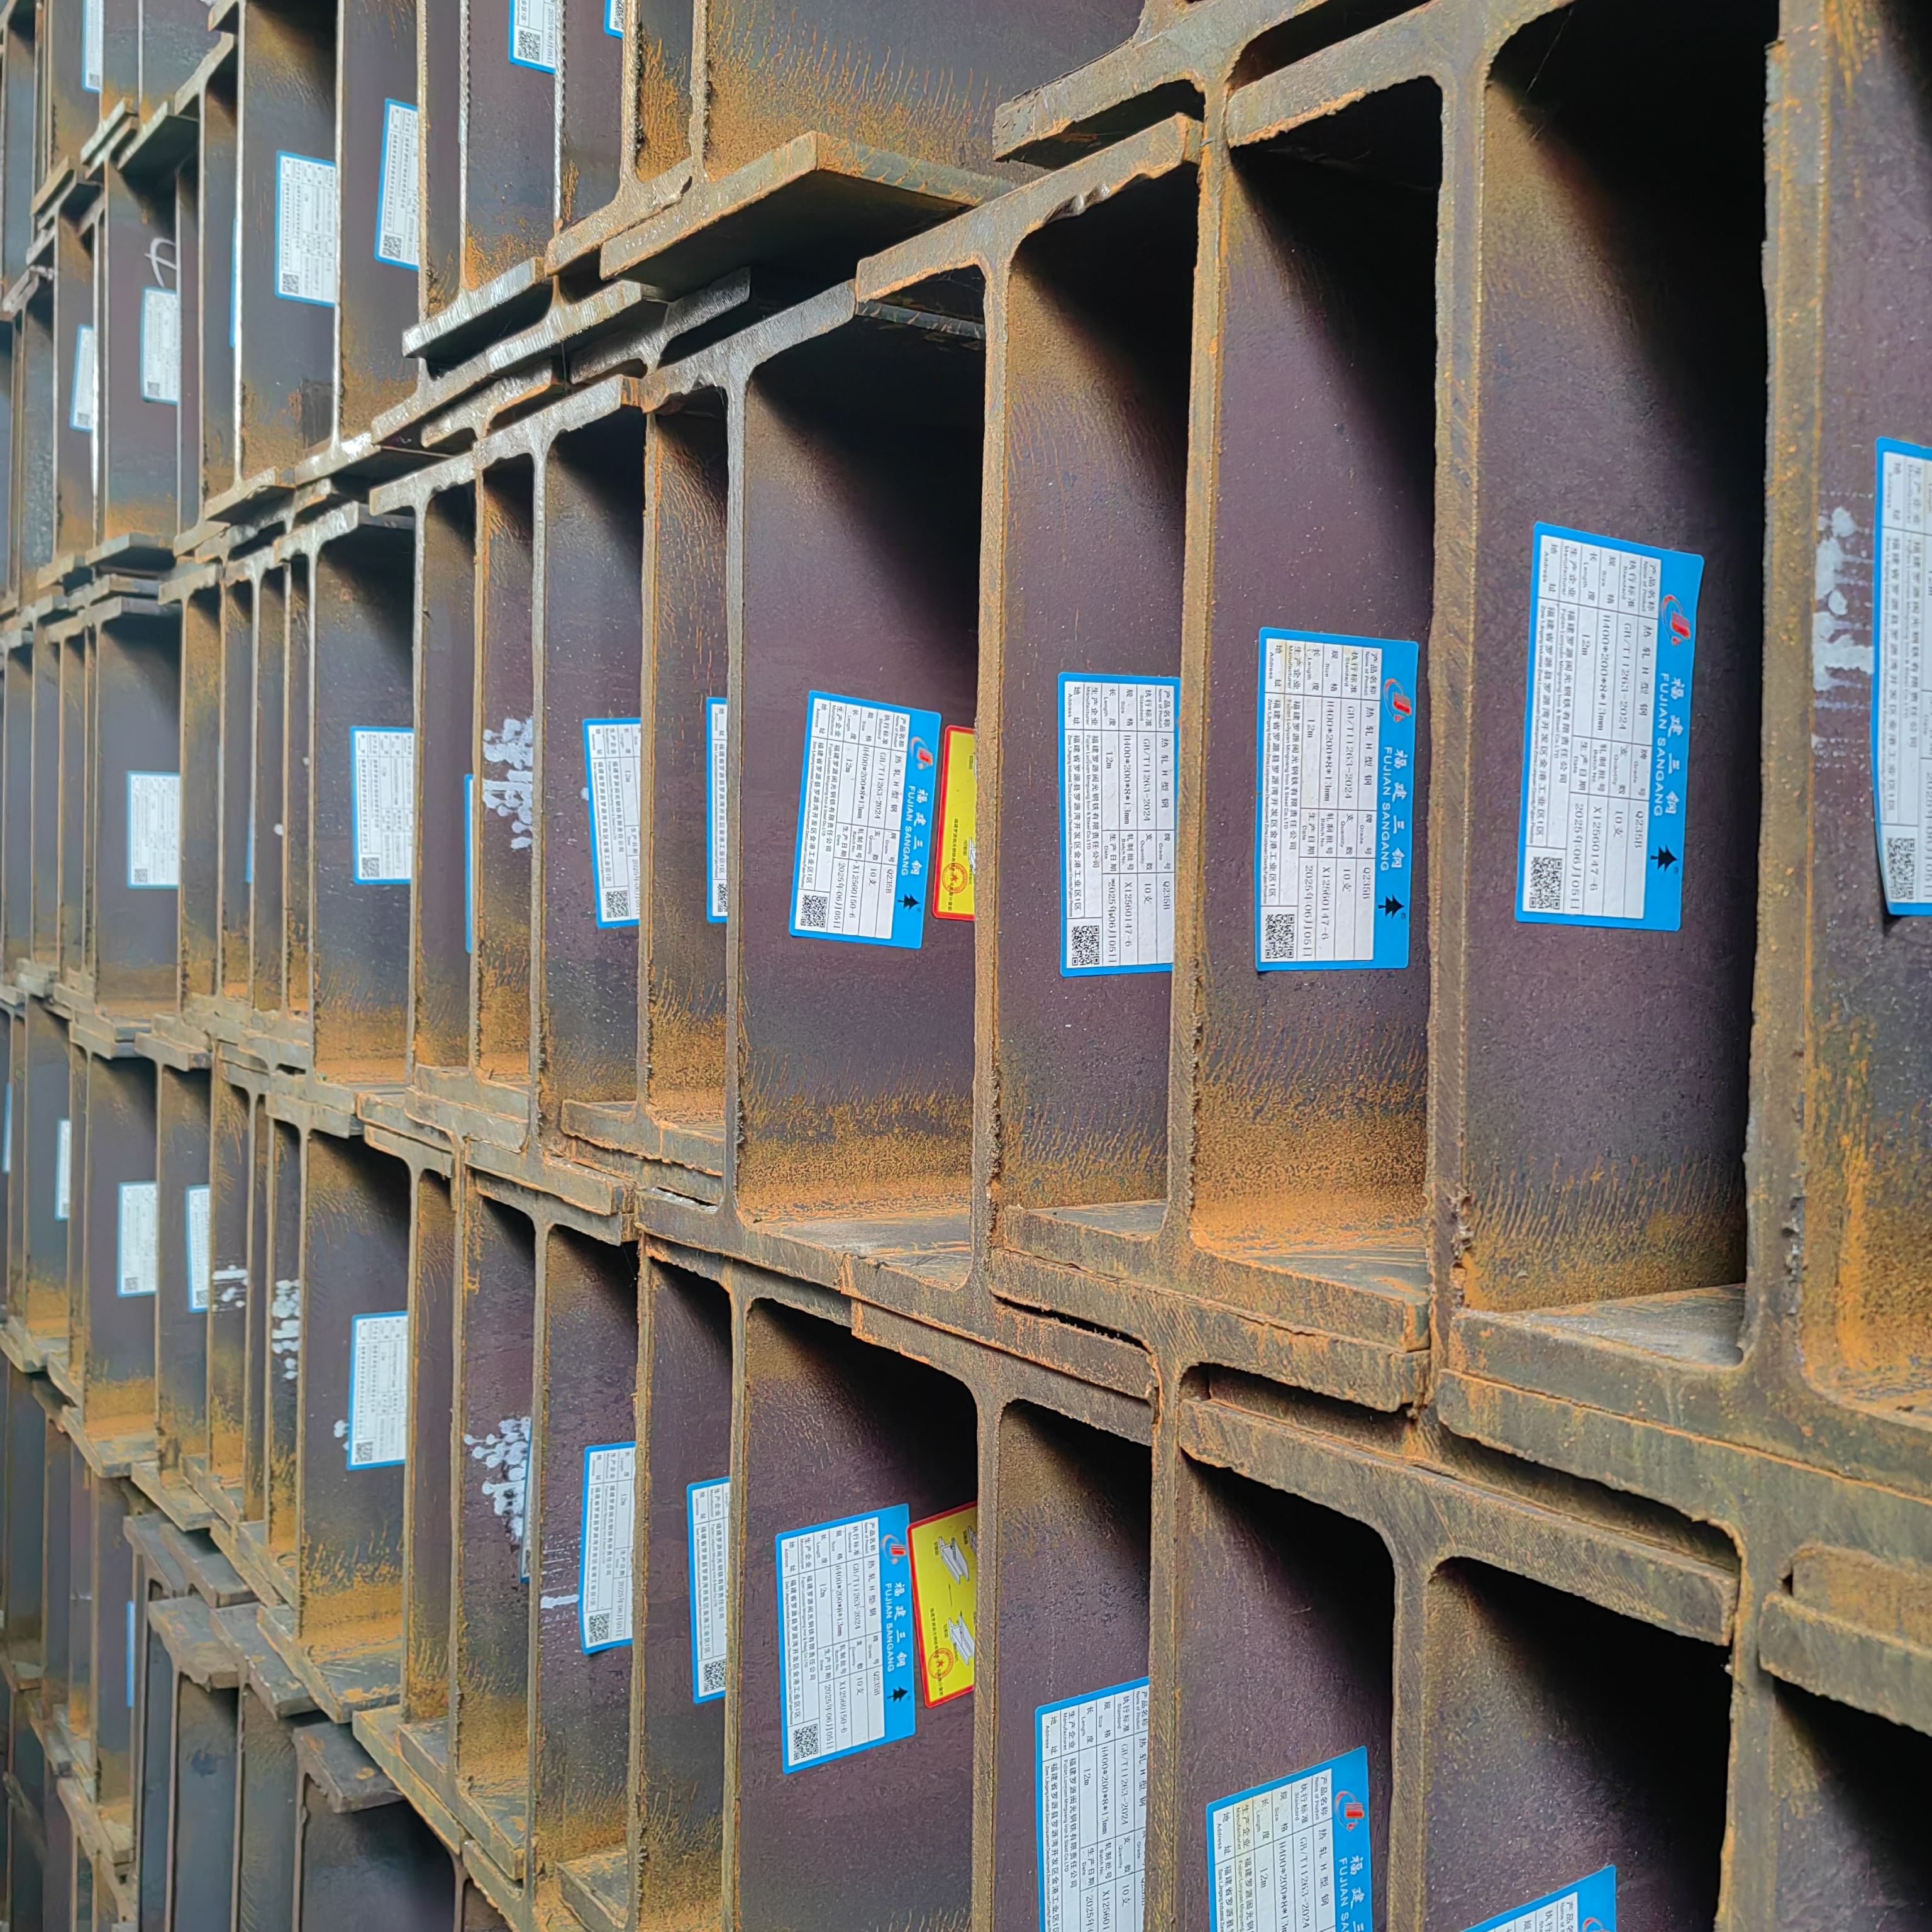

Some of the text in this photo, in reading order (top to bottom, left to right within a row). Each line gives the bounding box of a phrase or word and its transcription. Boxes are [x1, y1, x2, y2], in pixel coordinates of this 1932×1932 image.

[1567, 547, 1577, 597] 生产企业
[1626, 559, 1636, 608] 执行标准
[1646, 563, 1657, 612] 产品名称
[1580, 633, 1590, 656] 12m
[1292, 646, 1301, 690] 生产企业
[1349, 651, 1358, 694] 执行标准
[1368, 652, 1377, 696] 产品名称
[833, 706, 843, 738] 生产企业
[881, 714, 890, 745] 执行标准
[897, 716, 906, 747] 产品名称
[1306, 719, 1315, 738] 12m
[1652, 671, 1669, 816] FUJIAN SANGANG
[844, 758, 852, 773] 12m
[1105, 751, 1113, 769] 12m
[1343, 706, 1355, 799] GB/T11263-2024
[1363, 706, 1374, 786] 热轧H型钢
[1577, 740, 1588, 791] 生产日期
[1663, 675, 1685, 814] 福建三钢
[873, 752, 886, 819] GB/T11263-2024
[1141, 738, 1150, 821] GB/T11263-2024
[1160, 738, 1169, 808] 热轧H型钢
[900, 785, 915, 875] FUJIAN SANGANG
[909, 787, 928, 875] 福建三钢
[1380, 747, 1392, 872] FUJIAN SANGANG
[1391, 749, 1408, 869] 福建三钢
[1613, 810, 1623, 838] 10支
[1633, 810, 1643, 848] Q235B
[839, 826, 849, 858] 生产日期
[1109, 833, 1117, 872] 生产日期
[1126, 833, 1134, 871] 轧制批号
[1307, 813, 1316, 857] 生产日期
[1325, 814, 1335, 856] 轧制批号
[847, 865, 860, 918] X12560150-6
[868, 867, 877, 886] 10支
[884, 869, 893, 893] Q235B
[1143, 882, 1152, 904] 10支
[1162, 880, 1170, 910] Q235B
[1341, 867, 1351, 892] 10支
[1361, 867, 1370, 899] Q235B
[1124, 882, 1133, 947] X12560147-6
[1320, 867, 1331, 940] X12560147-6
[884, 1582, 894, 1672] FUJIAN SANGANG
[892, 1580, 908, 1667] 福建三钢
[1082, 1768, 1091, 1787] 12m
[1319, 1774, 1328, 1818] 产品名称
[1241, 1803, 1250, 1848] 生产企业
[1299, 1782, 1309, 1825] 执行标准
[1086, 1847, 1094, 1887] 生产日期
[1259, 1867, 1268, 1889] 12m
[1298, 1835, 1309, 1929] GB/T11263-2024
[1338, 1857, 1348, 1909] FUJIAN
[1121, 1882, 1130, 1907] 10支
[1243, 1855, 1253, 1932] 福建罗源闽光钢
